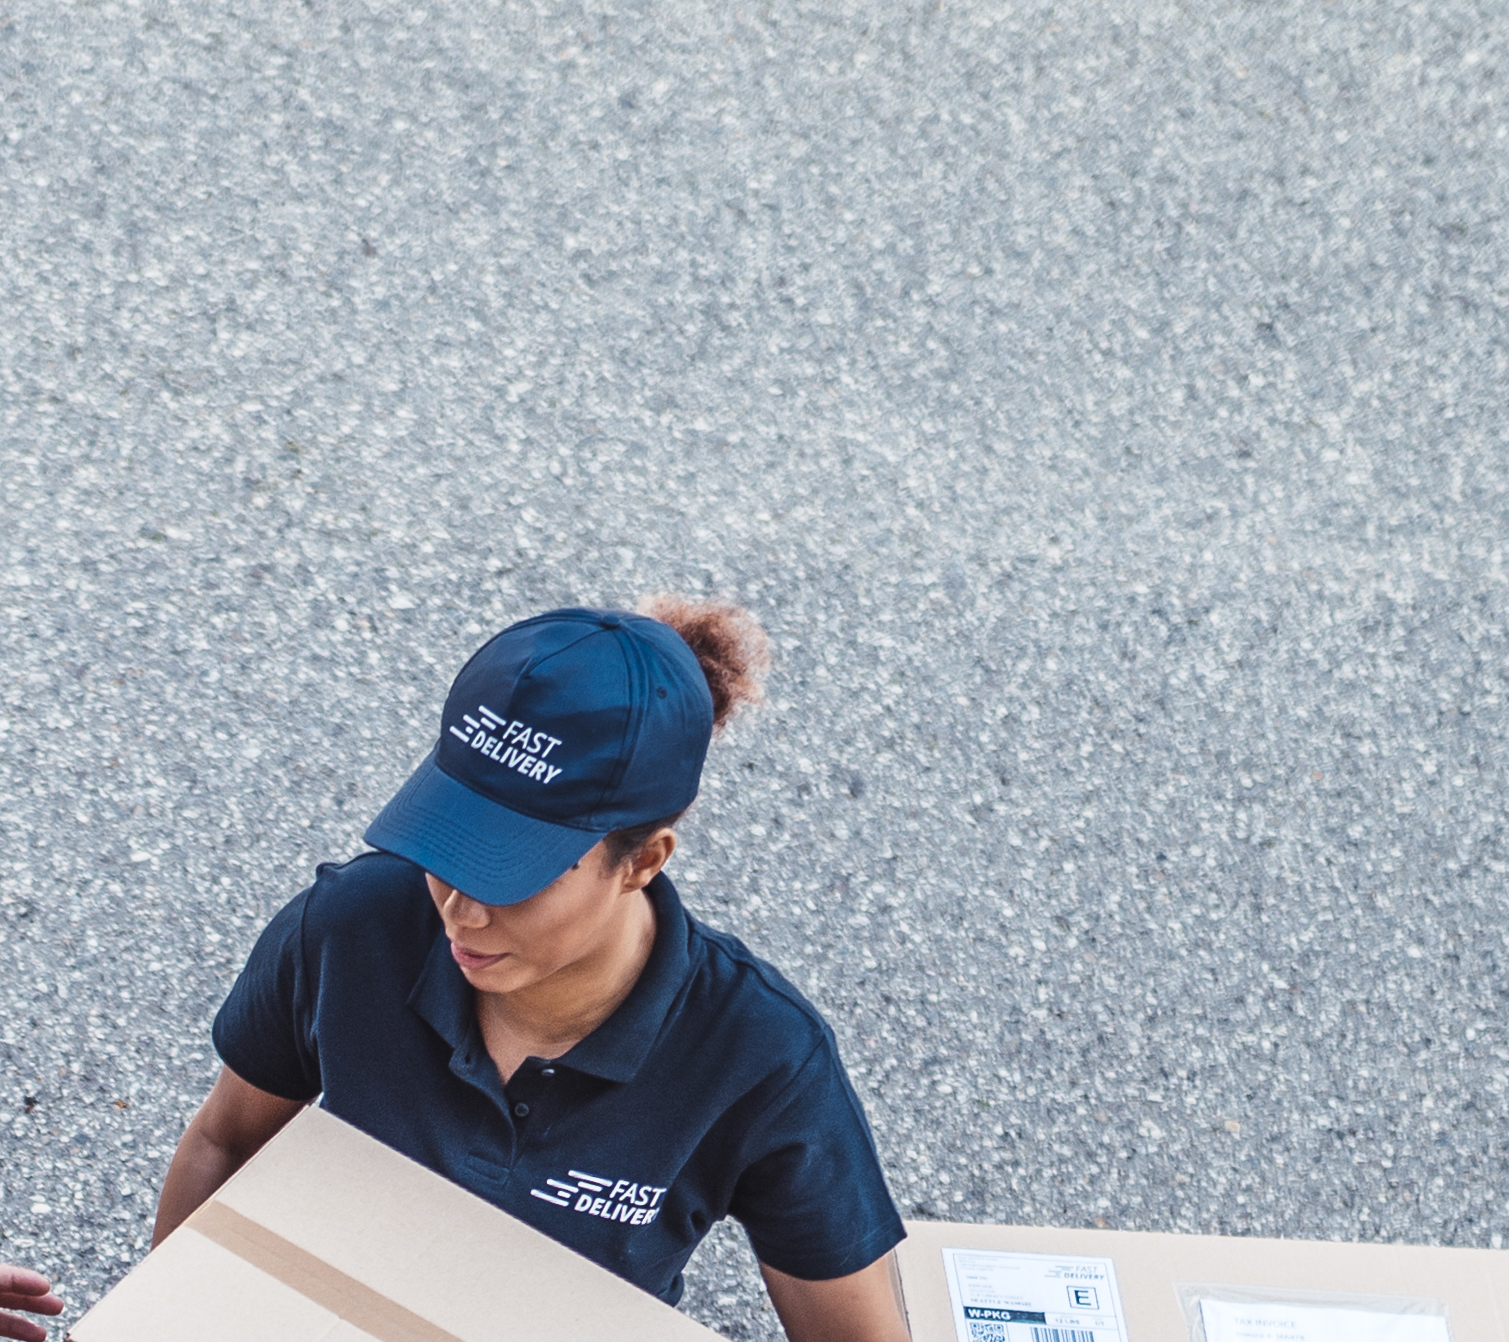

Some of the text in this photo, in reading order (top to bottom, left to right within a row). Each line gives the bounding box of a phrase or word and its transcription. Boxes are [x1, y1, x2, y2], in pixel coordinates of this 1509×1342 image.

[502, 721, 563, 758] FAST
[470, 730, 563, 784] DELIVERY
[609, 1179, 667, 1207] FAST
[1063, 1272, 1104, 1280] DELIVERY
[1075, 1265, 1097, 1273] FAST
[1073, 1289, 1091, 1306] E
[968, 1309, 1010, 1320] W-PKG
[1234, 1317, 1297, 1329] TAX INVOICE
